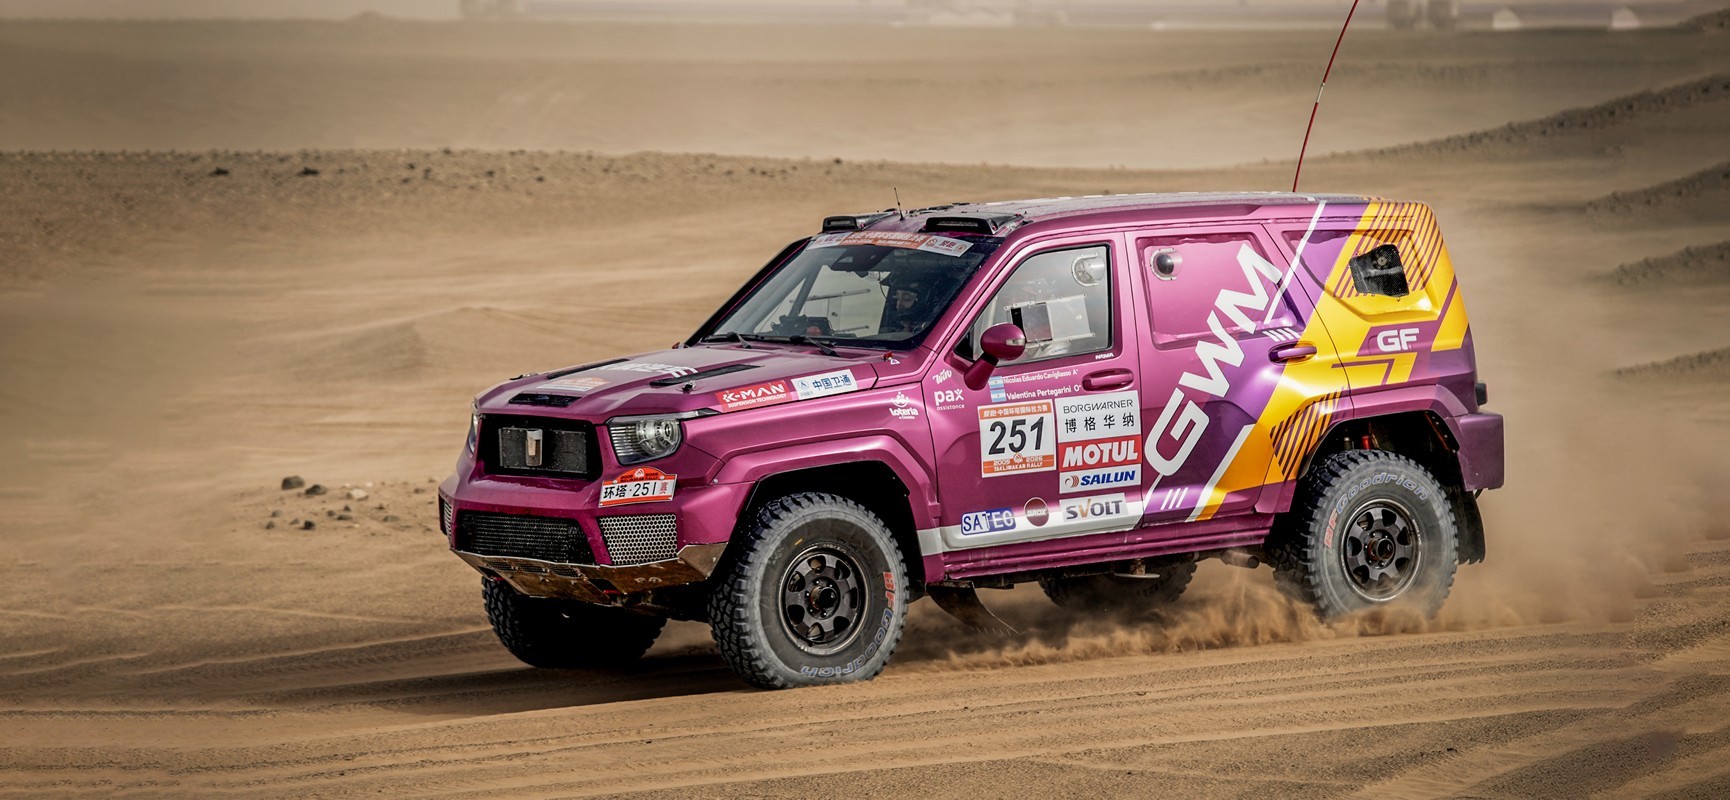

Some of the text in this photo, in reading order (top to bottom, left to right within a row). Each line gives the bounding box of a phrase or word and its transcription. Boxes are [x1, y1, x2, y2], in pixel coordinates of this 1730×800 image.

[1377, 328, 1419, 352] GF
[1145, 243, 1283, 476] GWM
[812, 374, 852, 391] 中国卫通
[1043, 370, 1071, 379] Cavigliasso
[723, 383, 785, 402] K-MAN
[728, 397, 756, 408] SUSPENSION
[757, 393, 787, 404] TECHNOLOGY
[934, 389, 964, 406] pax
[1006, 391, 1036, 400] Valentina
[1037, 386, 1072, 396] Pertegarini
[1063, 399, 1133, 414] BORGWARNER
[1065, 412, 1135, 433] 博格华纳
[988, 416, 1044, 455] 251
[1062, 440, 1138, 468] MOTUL
[1080, 470, 1136, 486] SAILUN
[1066, 498, 1123, 520] SVOLT
